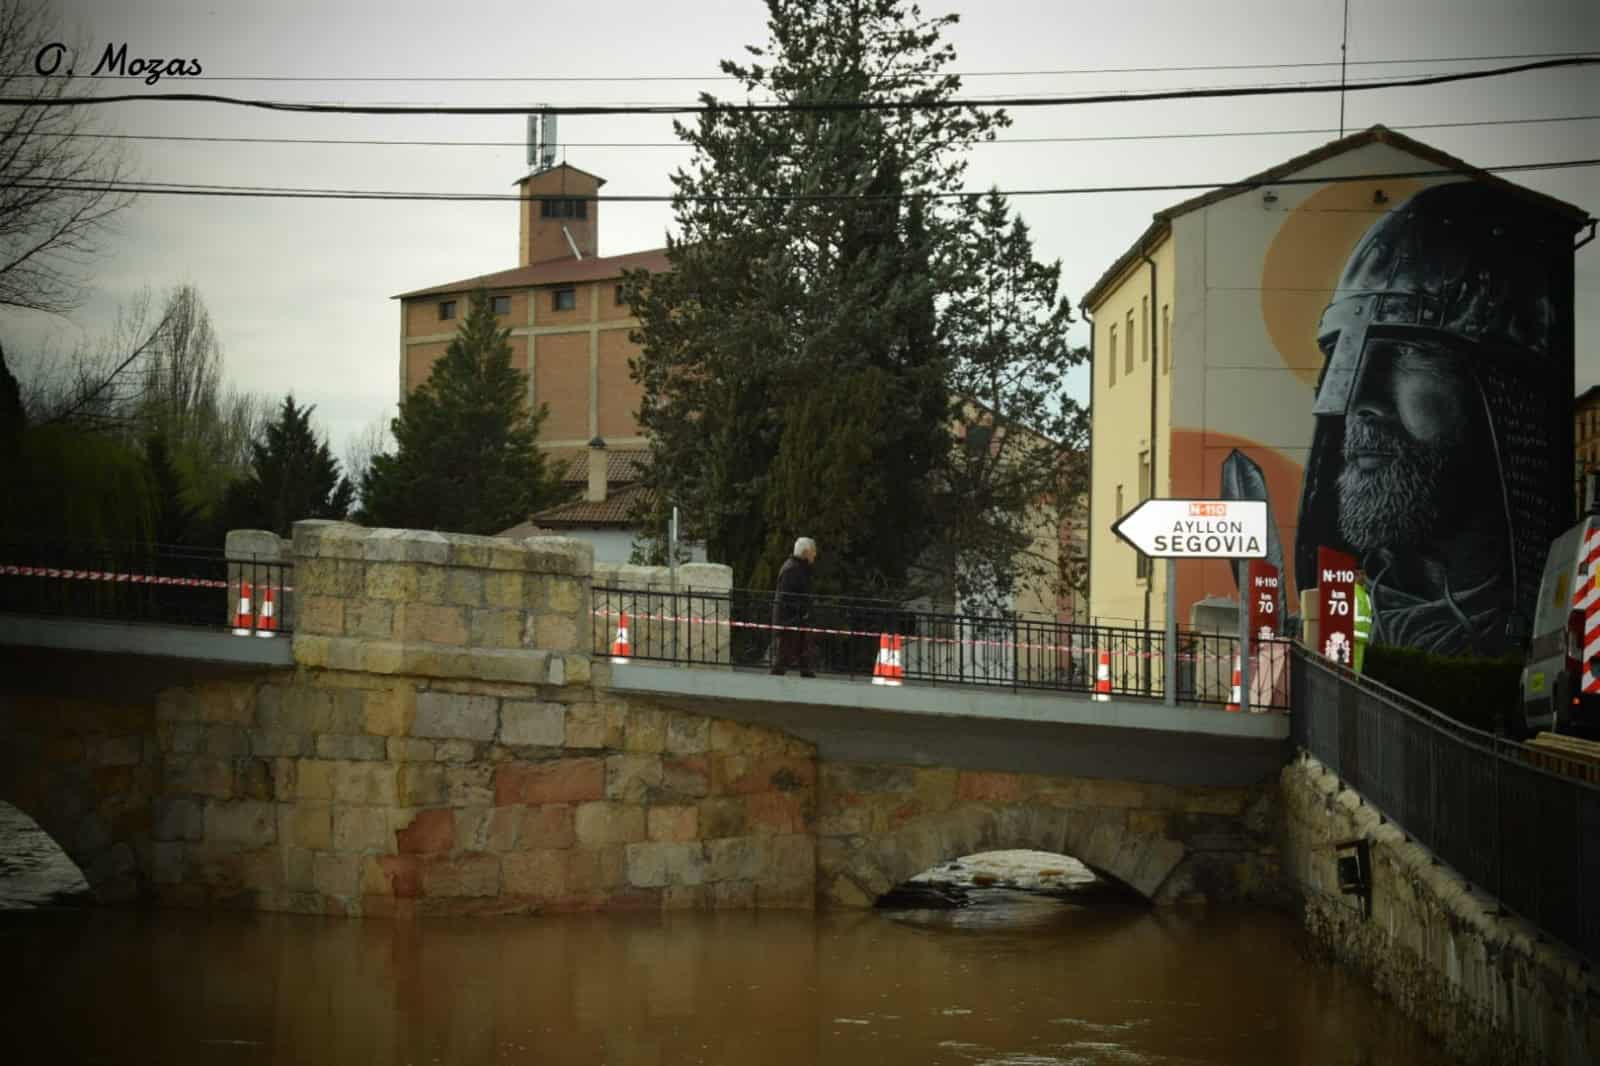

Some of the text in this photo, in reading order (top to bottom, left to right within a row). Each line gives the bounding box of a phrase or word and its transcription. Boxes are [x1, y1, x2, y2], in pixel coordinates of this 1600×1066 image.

[1189, 503, 1226, 516] N-110
[1173, 520, 1242, 534] AYLLON
[1154, 535, 1260, 553] SEGOVIA
[1255, 576, 1278, 588] N-110
[1322, 569, 1354, 583] N-110
[1331, 589, 1346, 599] km
[1258, 601, 1274, 613] 70
[1328, 600, 1349, 616] 70
